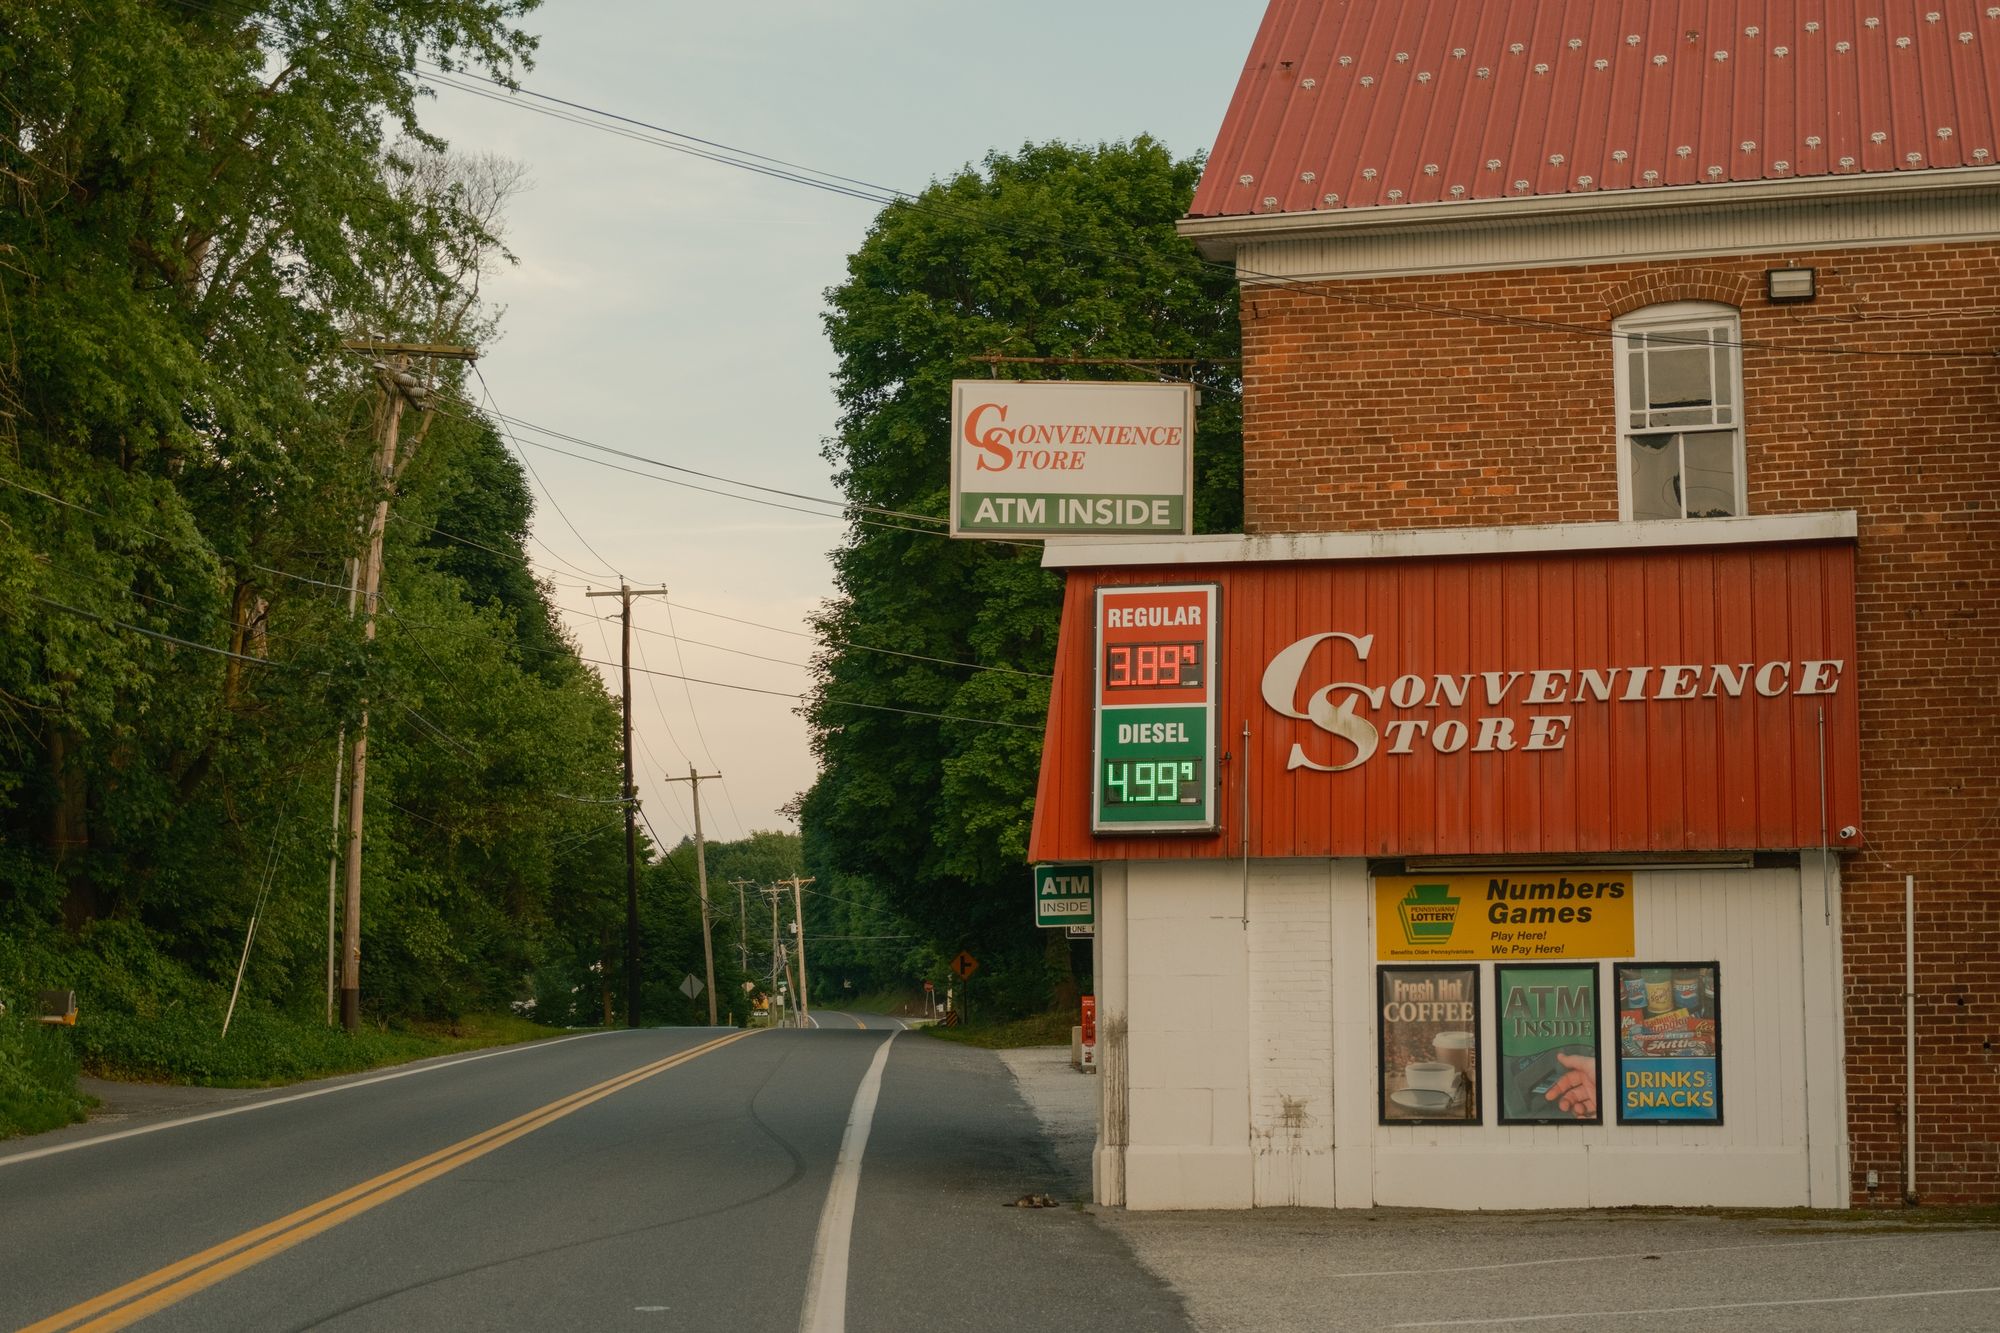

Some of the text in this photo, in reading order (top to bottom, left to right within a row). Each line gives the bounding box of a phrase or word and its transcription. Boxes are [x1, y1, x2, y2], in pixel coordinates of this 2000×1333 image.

[964, 403, 1182, 448] CONVENIENCE
[976, 427, 1086, 472] STORE
[973, 497, 1170, 525] ATM INSIDE
[1108, 605, 1201, 628] REGULAR
[1261, 631, 1844, 720] CONVENIENCE
[1118, 722, 1189, 744] DIESEL
[1286, 681, 1572, 772] STORE
[1041, 876, 1090, 896] ATM
[1486, 878, 1625, 900] Numbers
[1043, 901, 1088, 913] INSIDE
[1410, 913, 1456, 922] LOTTERY
[1487, 902, 1593, 925] Games
[1490, 931, 1547, 942] Play Here!
[1491, 944, 1565, 956] We Pay Here!
[1394, 979, 1463, 1001] Fresh Hot
[1383, 1002, 1475, 1023] COFFEE
[1503, 985, 1591, 1019] ATM
[1513, 1018, 1592, 1038] INSIDE
[1625, 1071, 1706, 1089] DRINKS
[1626, 1091, 1714, 1108] SNACKS
